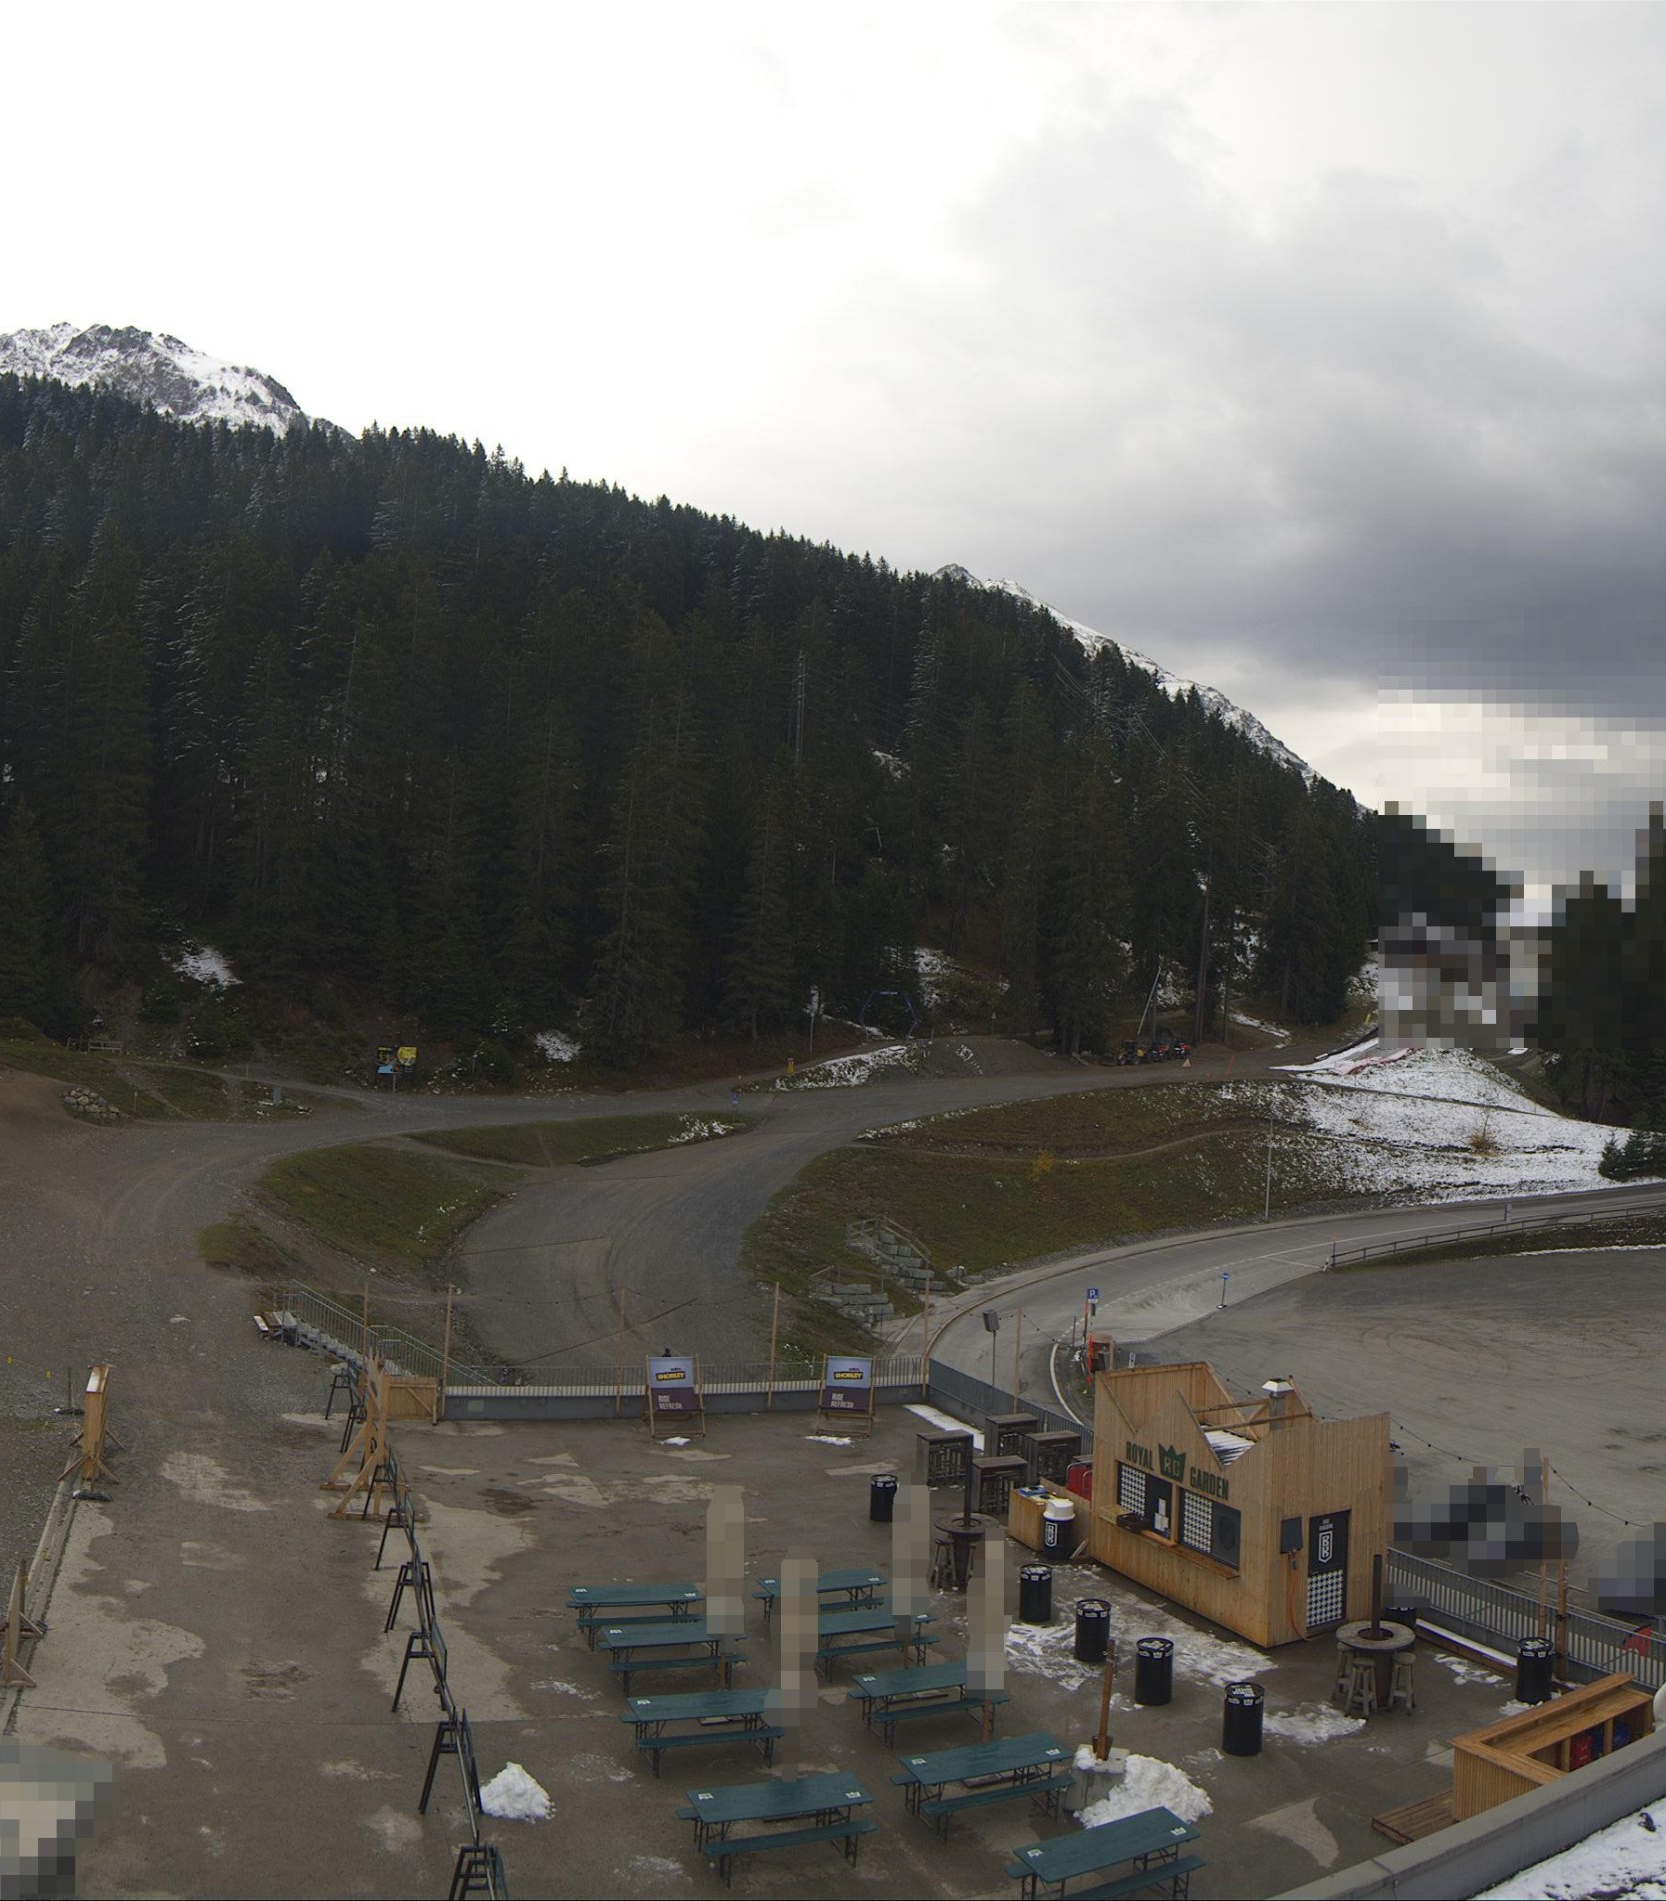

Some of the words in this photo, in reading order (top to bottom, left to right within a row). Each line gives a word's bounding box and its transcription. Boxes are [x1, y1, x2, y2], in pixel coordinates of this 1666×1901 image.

[1090, 1290, 1095, 1298] P
[1126, 1441, 1154, 1471] ROYAL
[1190, 1466, 1229, 1500] GARDEN
